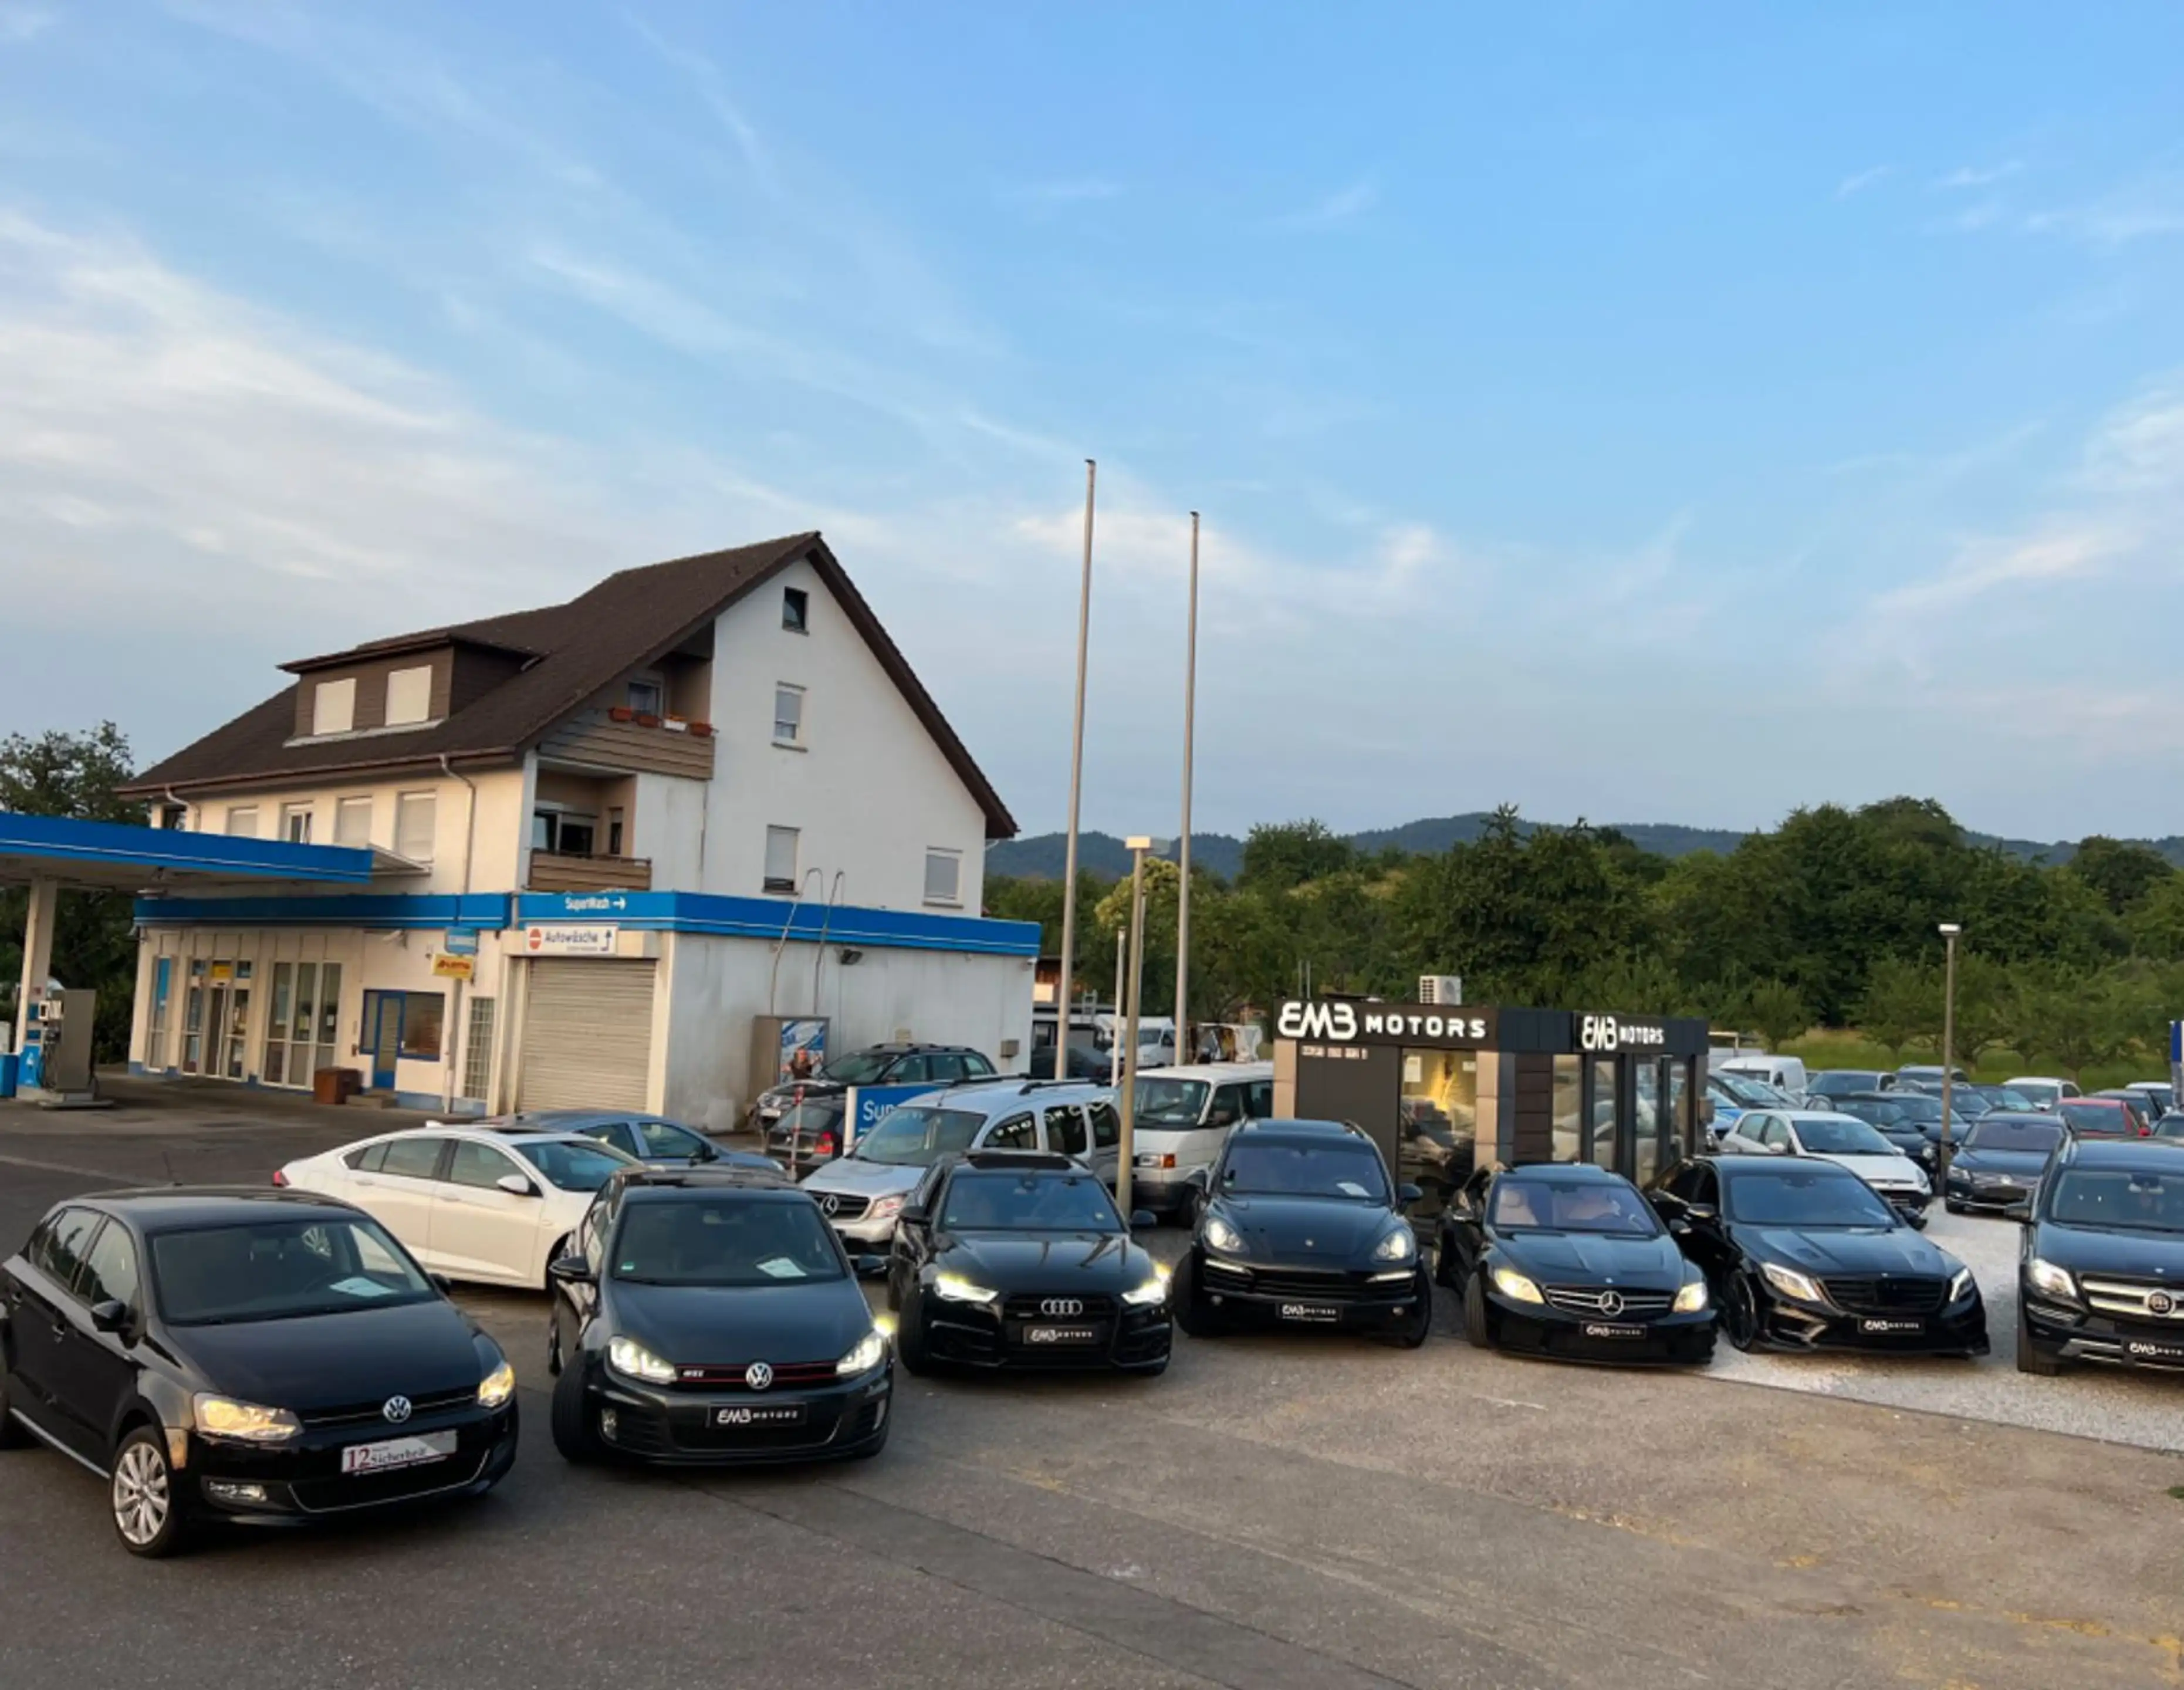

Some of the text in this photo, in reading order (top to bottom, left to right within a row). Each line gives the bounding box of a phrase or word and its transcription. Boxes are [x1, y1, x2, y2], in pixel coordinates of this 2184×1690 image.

[565, 897, 609, 912] SuperWash
[545, 930, 598, 943] Autowäsche
[1278, 1002, 1486, 1039] EMB MOTORS
[1582, 1016, 1665, 1050] EMB MOTORS
[716, 1408, 751, 1425] EMB
[349, 1446, 370, 1469] 12
